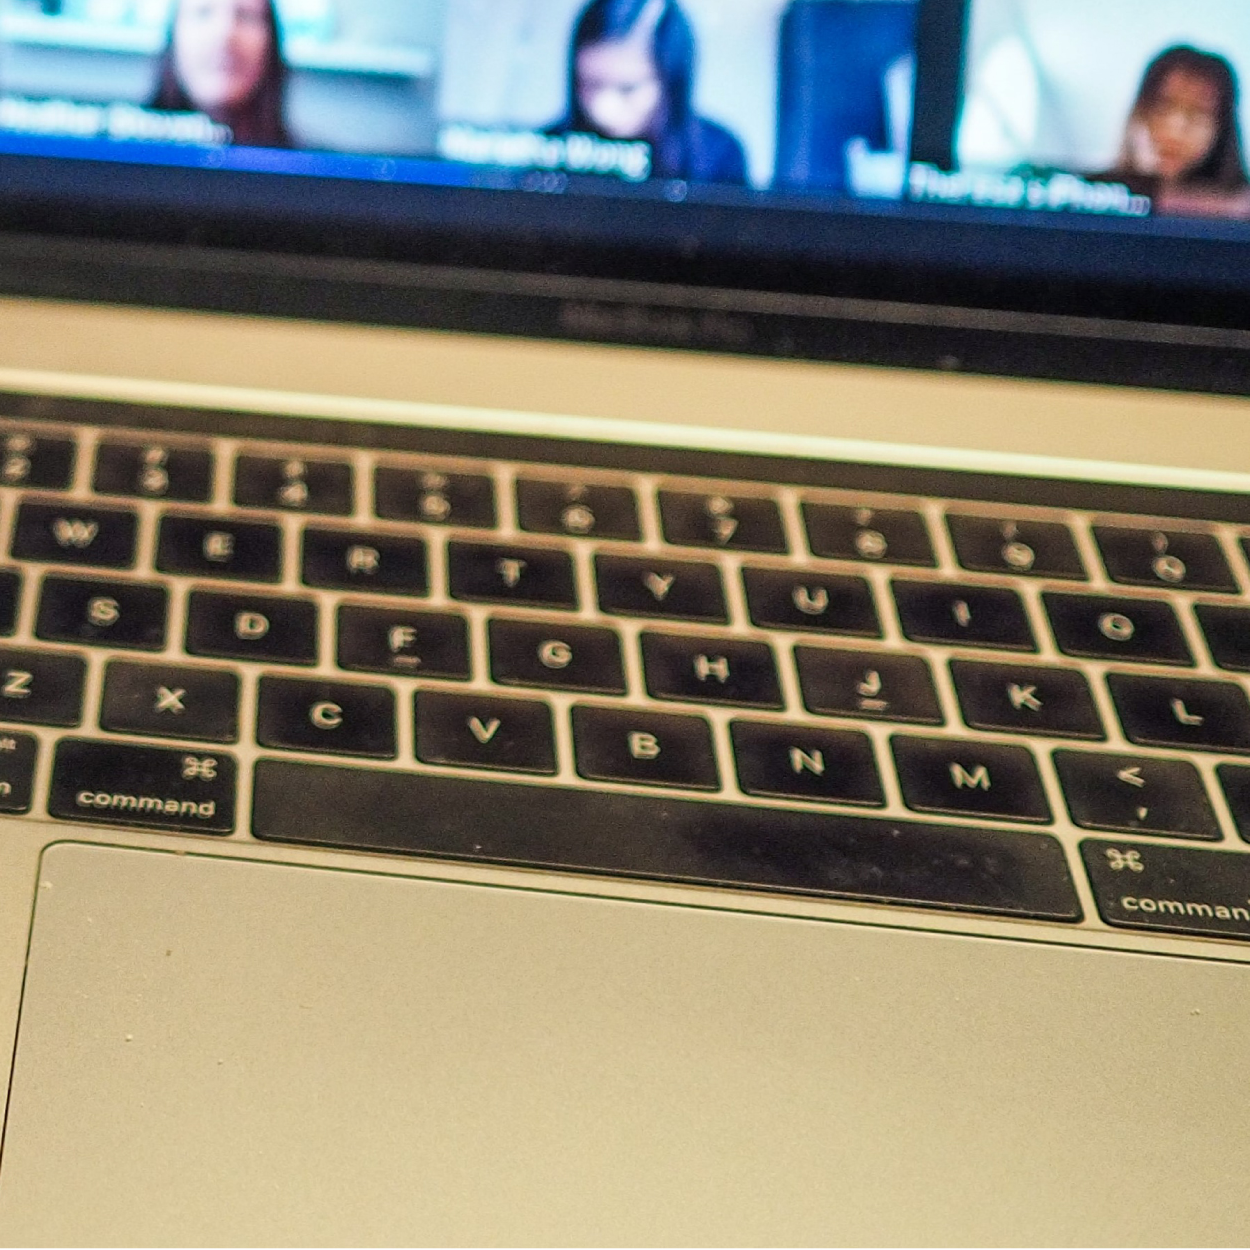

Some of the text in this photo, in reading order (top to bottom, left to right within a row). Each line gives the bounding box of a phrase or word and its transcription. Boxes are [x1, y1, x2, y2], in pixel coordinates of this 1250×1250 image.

[53, 520, 98, 545] W
[204, 532, 231, 562] E
[348, 546, 379, 572] R
[499, 558, 526, 587] T
[647, 572, 674, 600] Y
[89, 598, 120, 625] S
[792, 586, 829, 615] U
[235, 611, 270, 638] D
[1098, 613, 1135, 641] O
[388, 625, 417, 652] F
[538, 640, 573, 669] G
[694, 654, 730, 683] H
[3, 670, 33, 695] Z
[858, 671, 882, 696] J
[156, 686, 185, 713] X
[1007, 684, 1042, 711] K
[311, 702, 343, 729] C
[1171, 698, 1204, 726] L
[469, 716, 501, 744] V
[628, 731, 661, 759] B
[790, 747, 825, 775] N
[950, 763, 991, 790] M
[77, 791, 216, 817] command
[1121, 896, 1250, 921] comman
